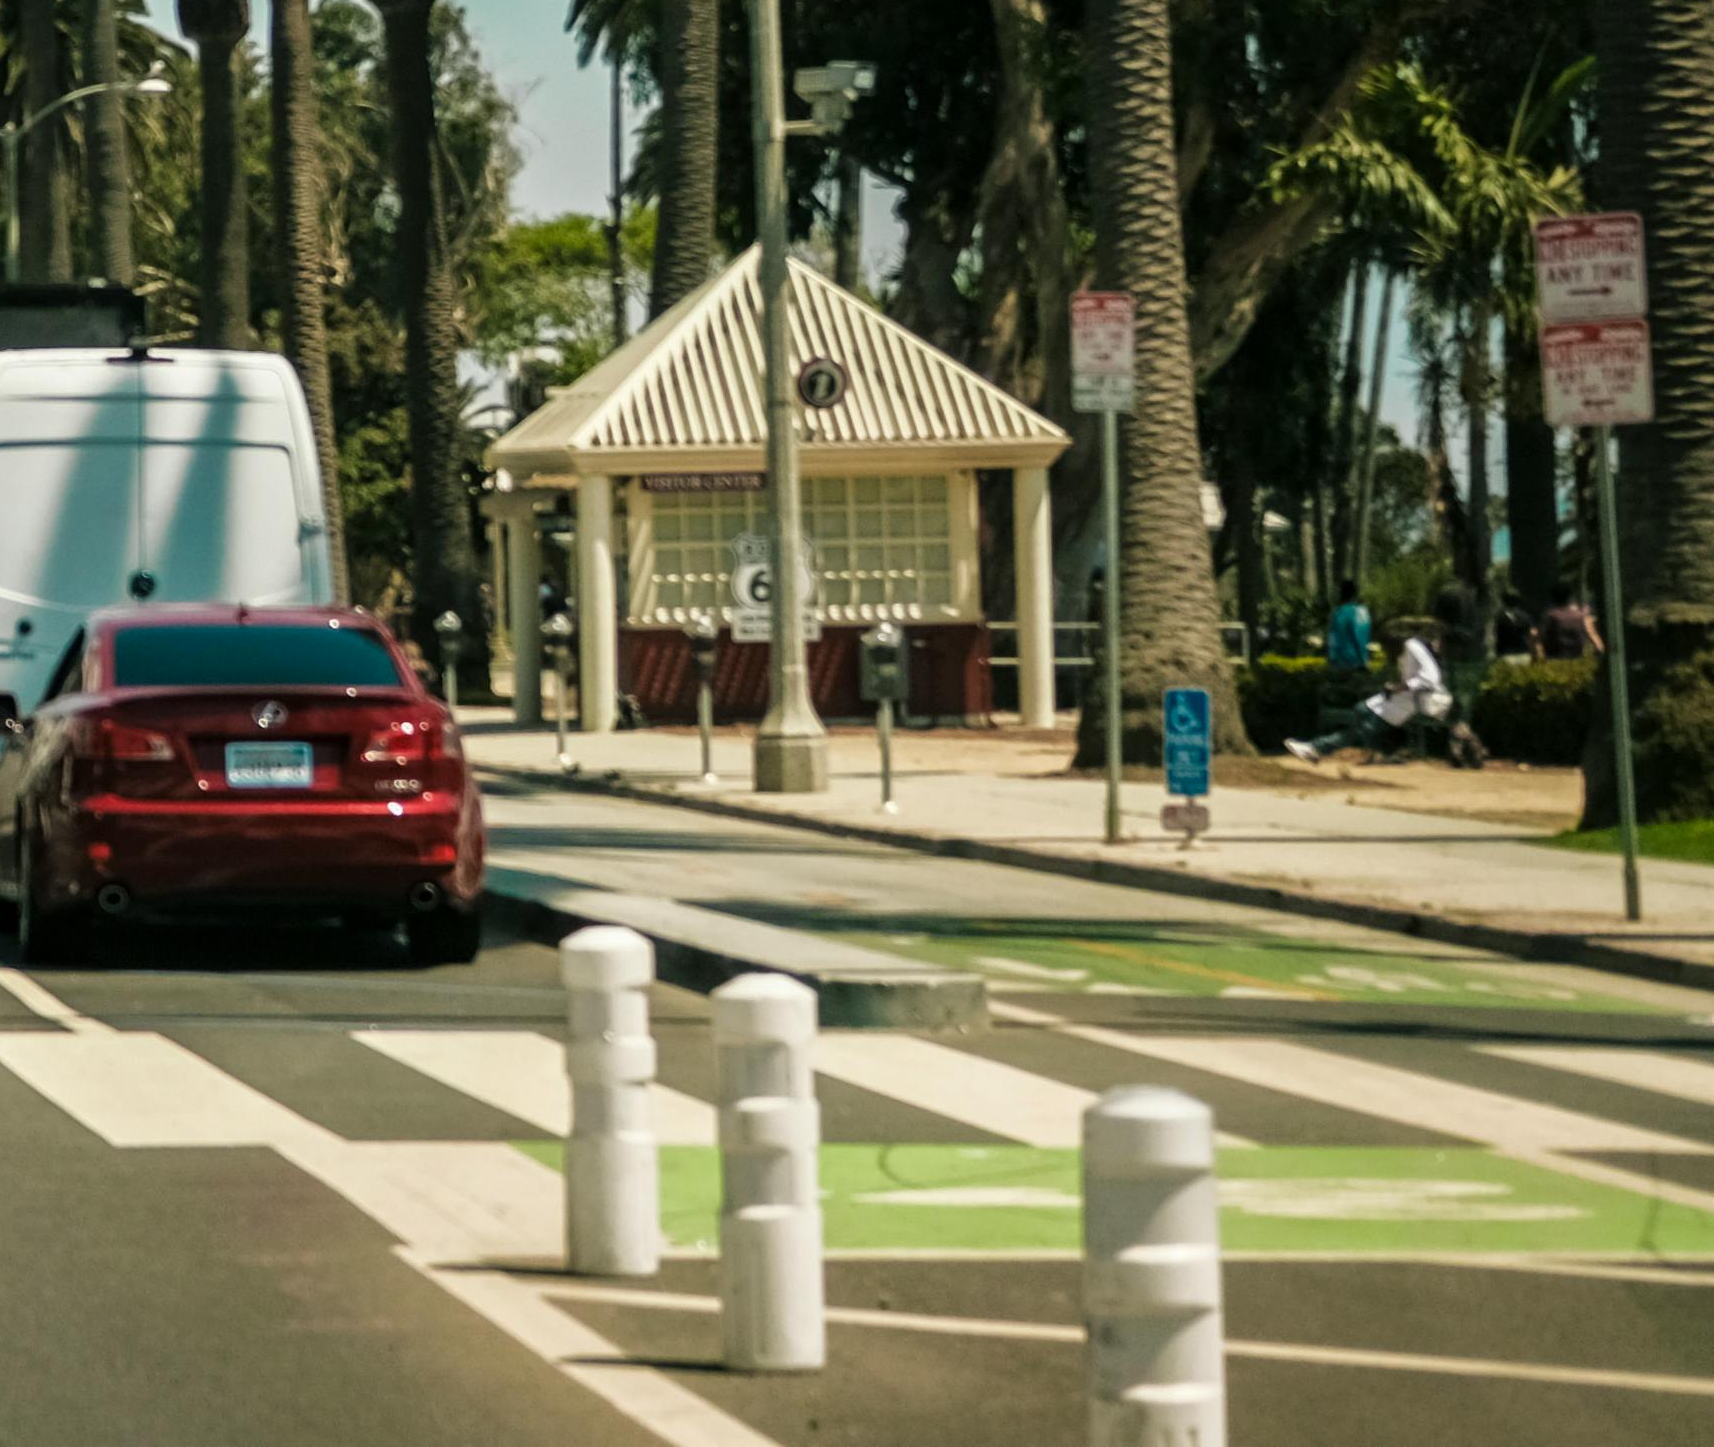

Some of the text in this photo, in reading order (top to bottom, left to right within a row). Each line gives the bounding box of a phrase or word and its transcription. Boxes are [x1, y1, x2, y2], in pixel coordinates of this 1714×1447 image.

[1547, 263, 1636, 283] ANY TIME
[644, 475, 762, 490] VISITOR CENTER
